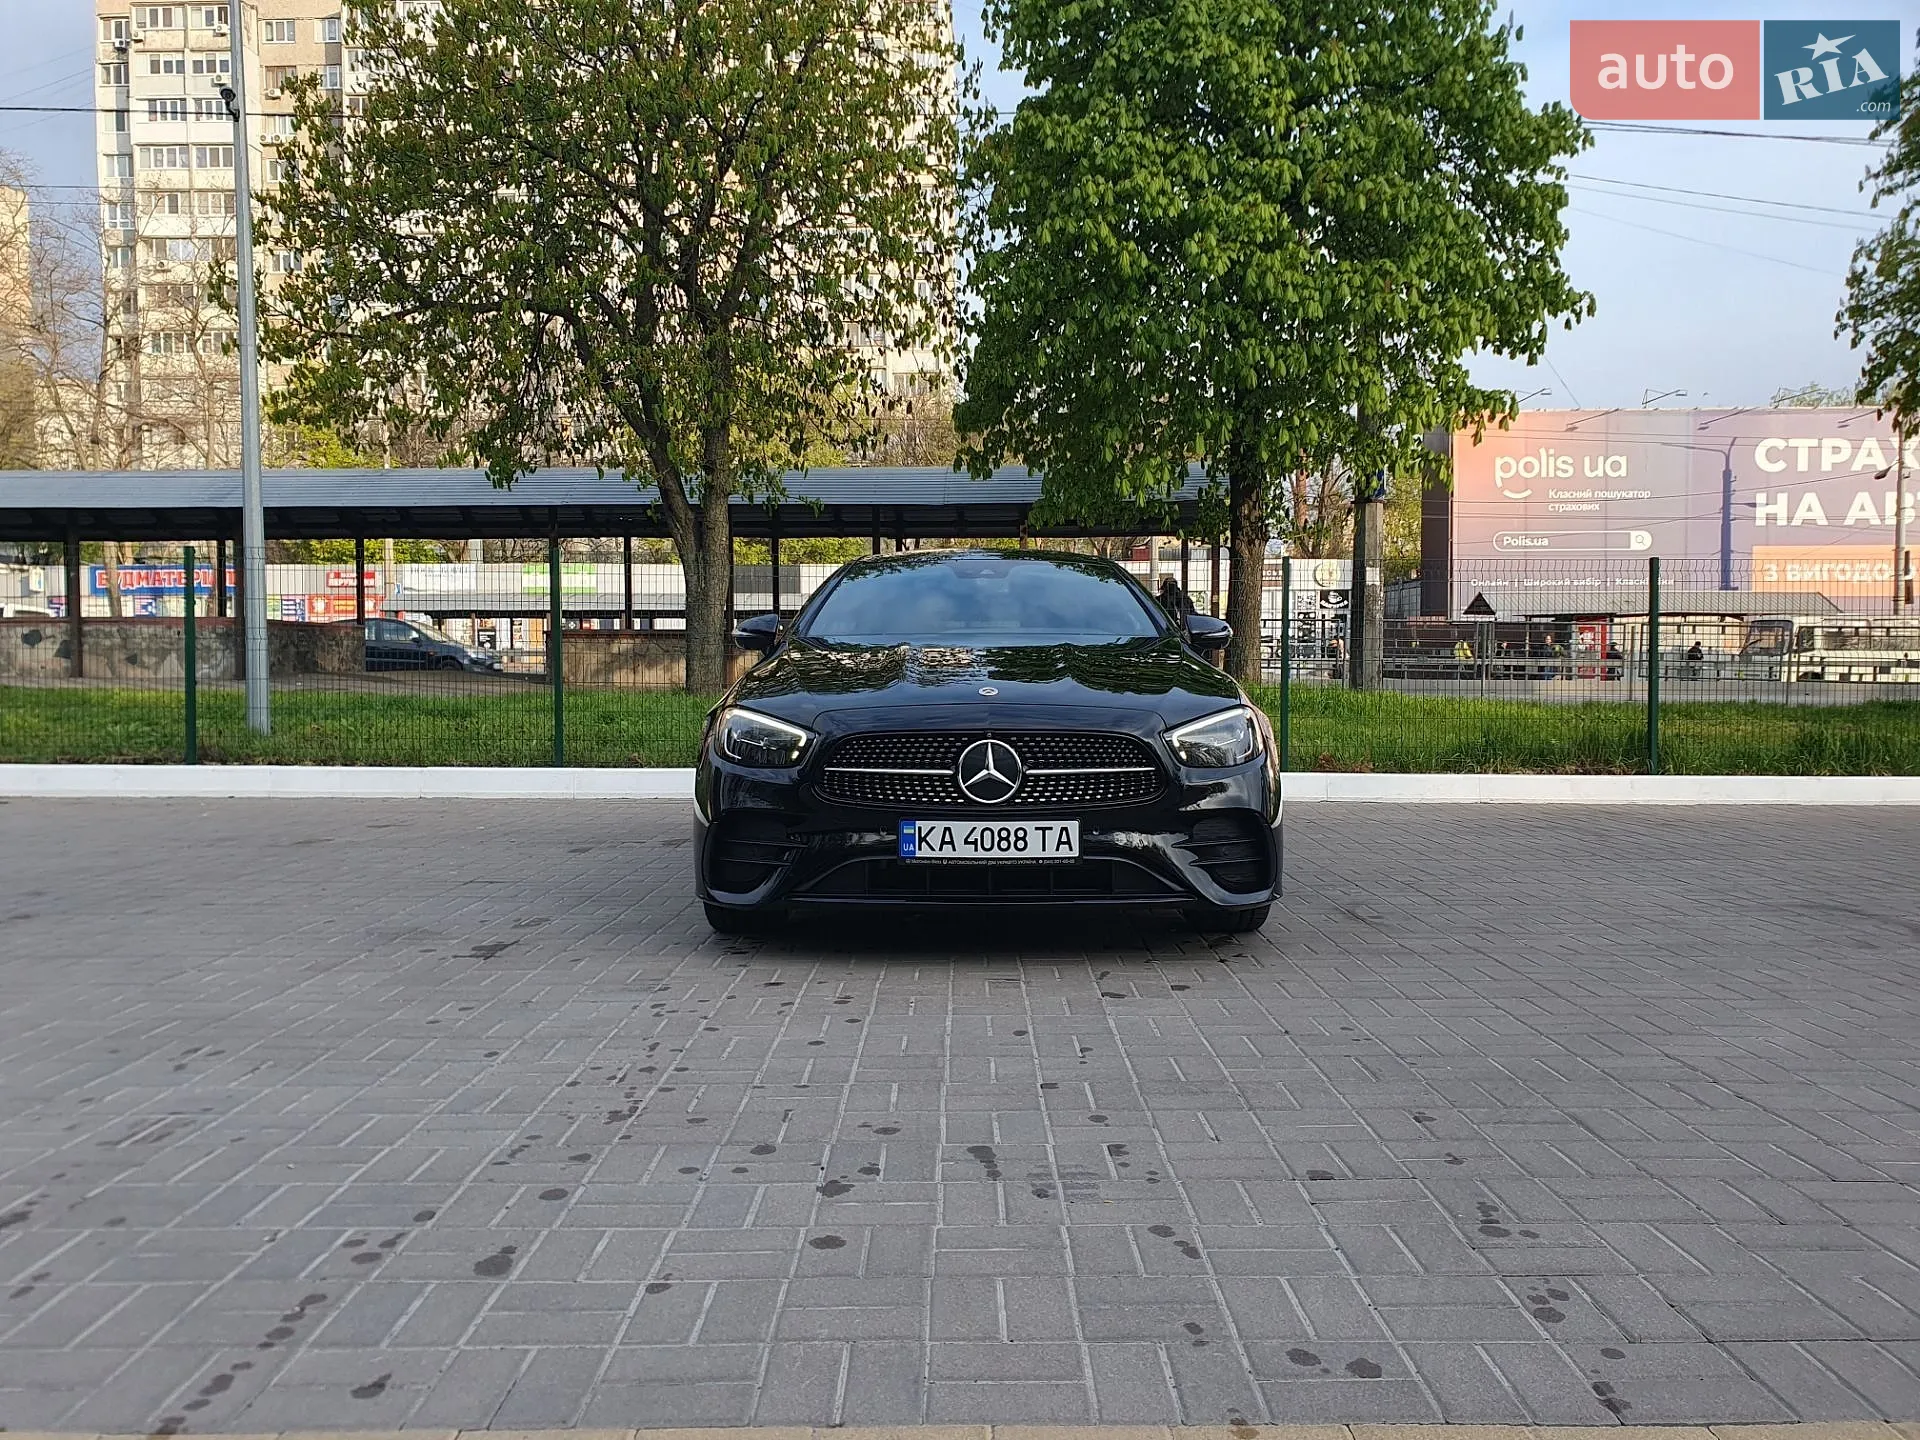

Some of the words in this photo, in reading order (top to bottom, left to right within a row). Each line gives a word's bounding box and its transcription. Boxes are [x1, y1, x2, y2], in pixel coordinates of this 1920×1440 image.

[1754, 437, 1920, 473] СТРАХ
[1495, 447, 1575, 489] polis
[1583, 454, 1628, 478] ua
[1548, 488, 1592, 499] Класний
[1594, 489, 1651, 501] пошукатор
[1548, 503, 1600, 513] страхових
[1755, 491, 1829, 527] НА
[1843, 490, 1920, 526] АВ
[1503, 535, 1549, 547] Polis.ua
[1470, 577, 1509, 587] Онлайн
[1523, 577, 1571, 587] Широкий
[917, 825, 957, 852] KA
[963, 825, 1028, 853] 4088
[1034, 825, 1074, 852] TA
[903, 843, 915, 851] UA
